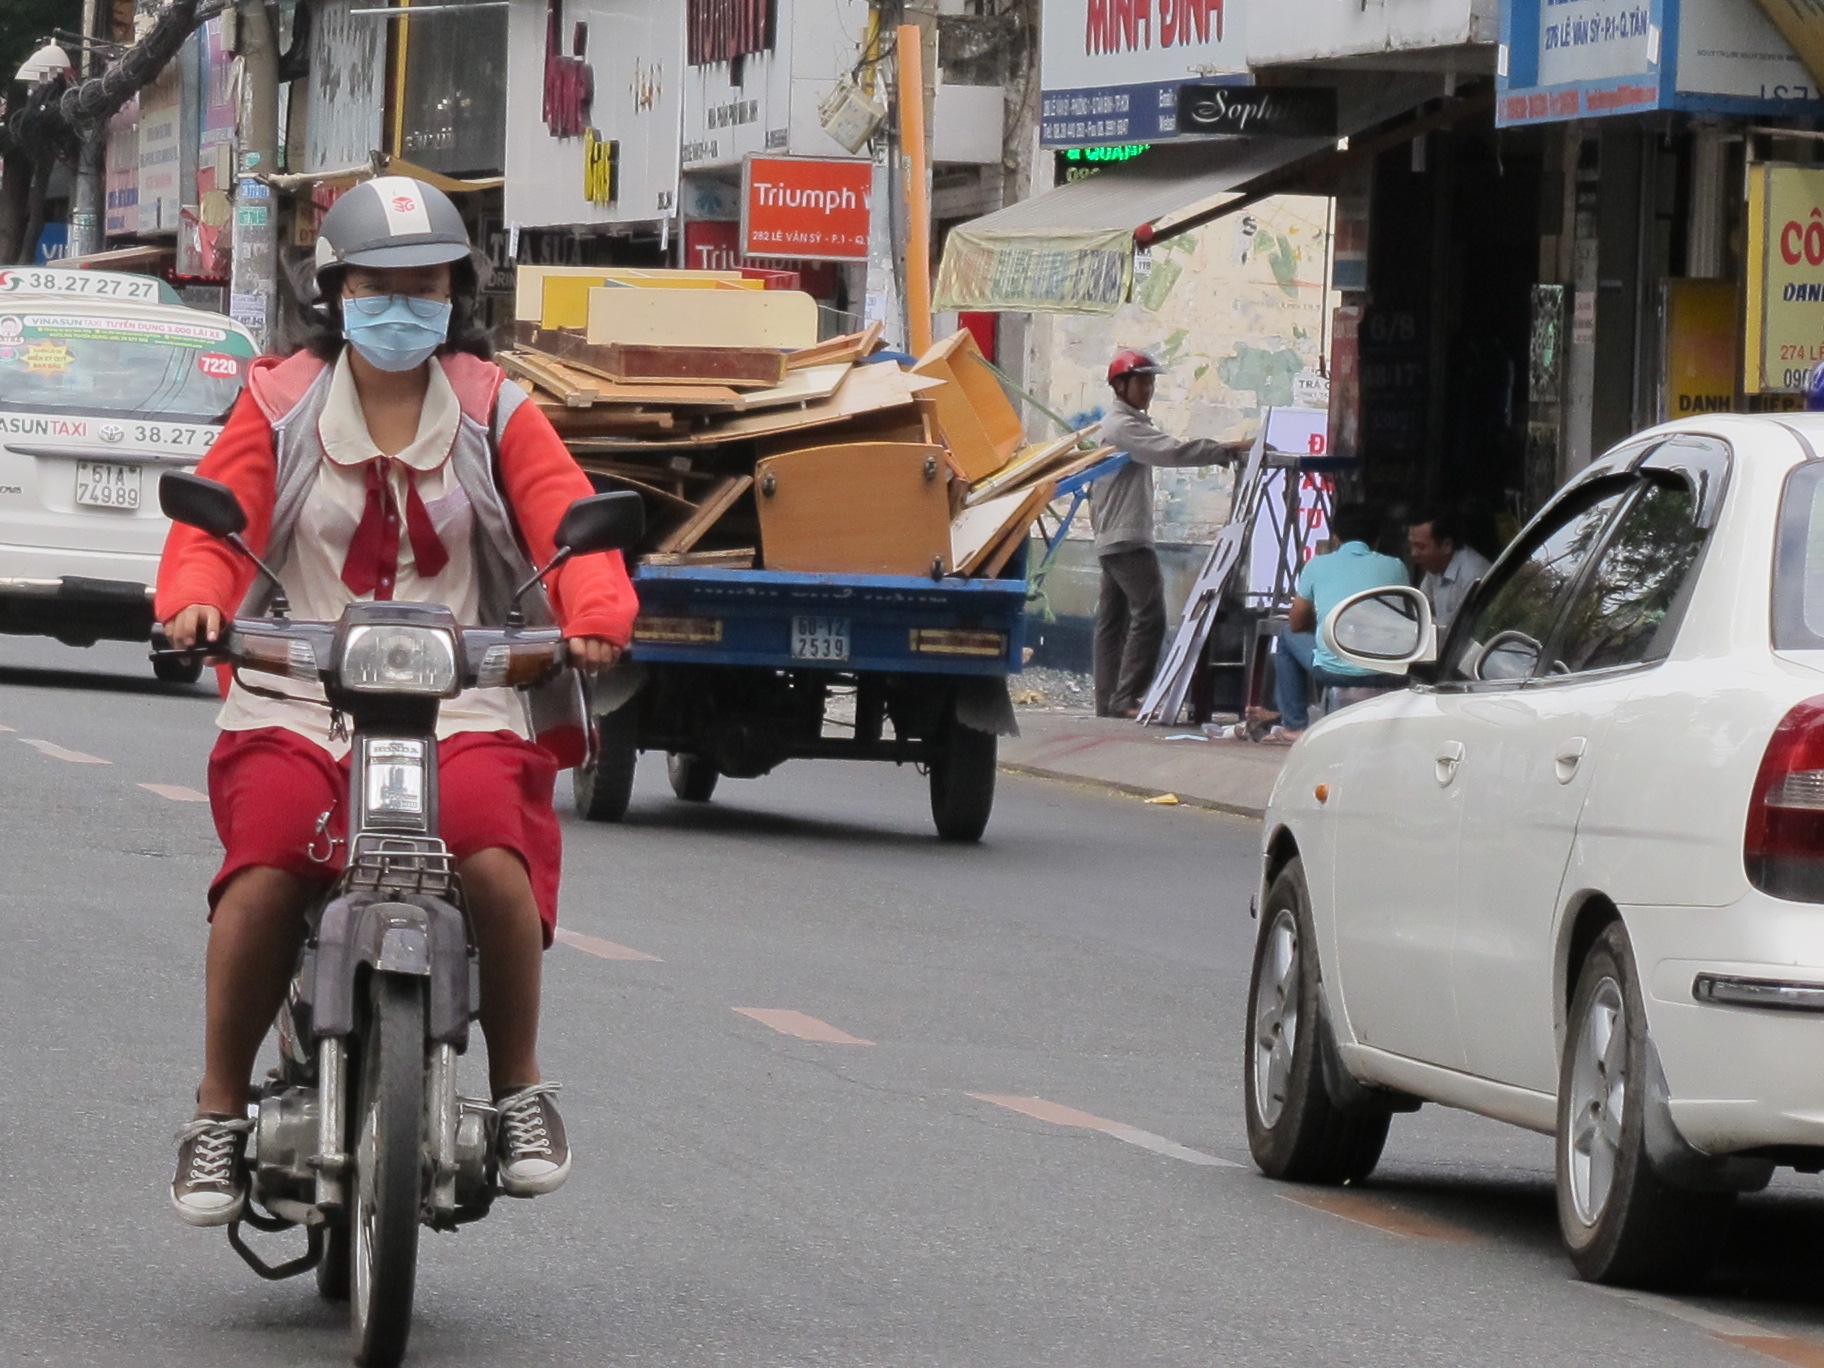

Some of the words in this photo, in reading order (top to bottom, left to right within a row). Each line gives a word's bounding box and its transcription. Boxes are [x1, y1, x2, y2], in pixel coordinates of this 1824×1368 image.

[753, 182, 856, 215] Triumph
[752, 231, 770, 241] 282
[29, 273, 92, 293] 38.27
[96, 278, 121, 296] 27
[128, 281, 154, 298] 27
[1783, 283, 1824, 303] DAN
[1781, 345, 1805, 361] 274
[201, 357, 237, 375] 7220
[1679, 394, 1731, 413] DANH
[134, 426, 197, 446] 38.27
[92, 465, 126, 487] 51A
[78, 483, 138, 506] 749.89
[798, 638, 844, 658] 2539
